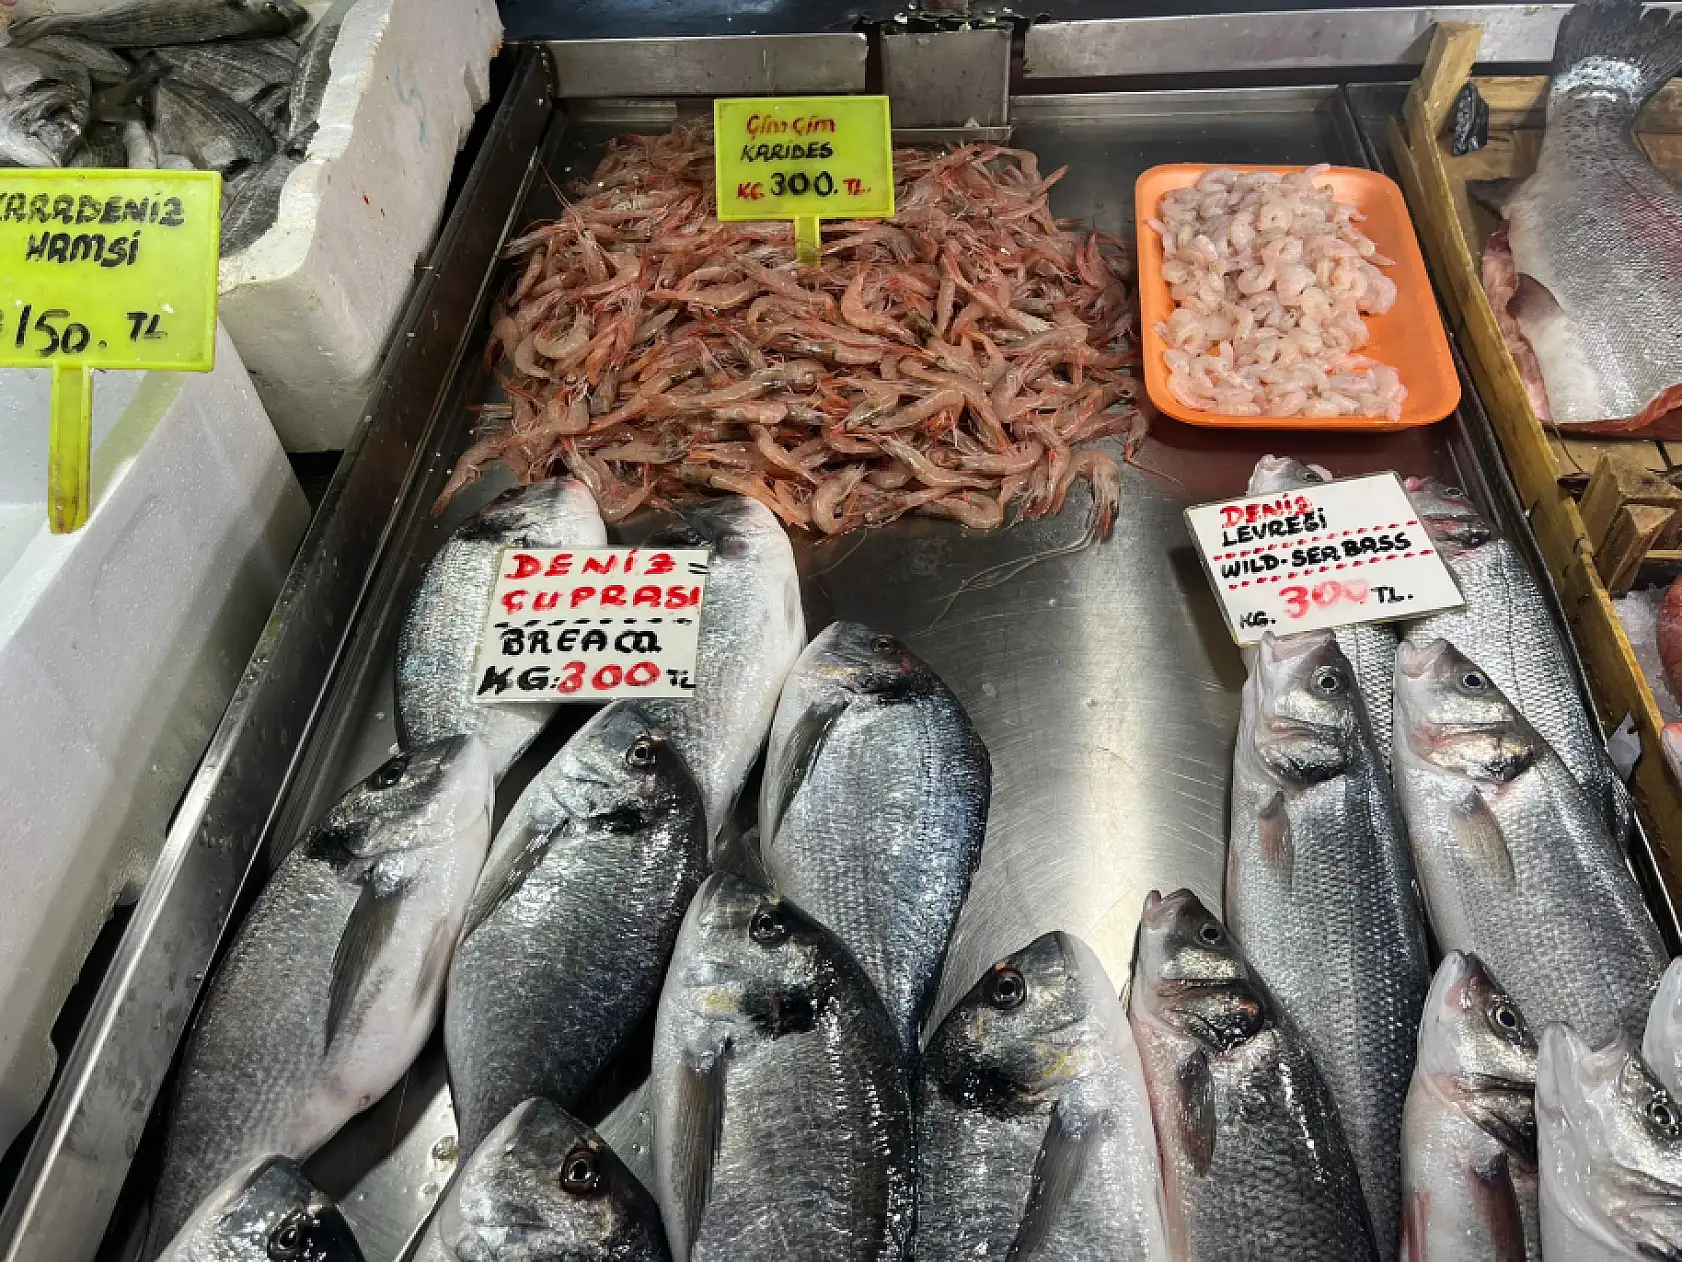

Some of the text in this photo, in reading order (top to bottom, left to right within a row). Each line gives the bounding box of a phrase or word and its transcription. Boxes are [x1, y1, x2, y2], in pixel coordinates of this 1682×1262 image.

[25, 229, 142, 268] HAMSİ
[126, 310, 168, 342] TL
[1278, 578, 1371, 621] 300
[557, 660, 661, 694] 300
[665, 668, 697, 690] TL
